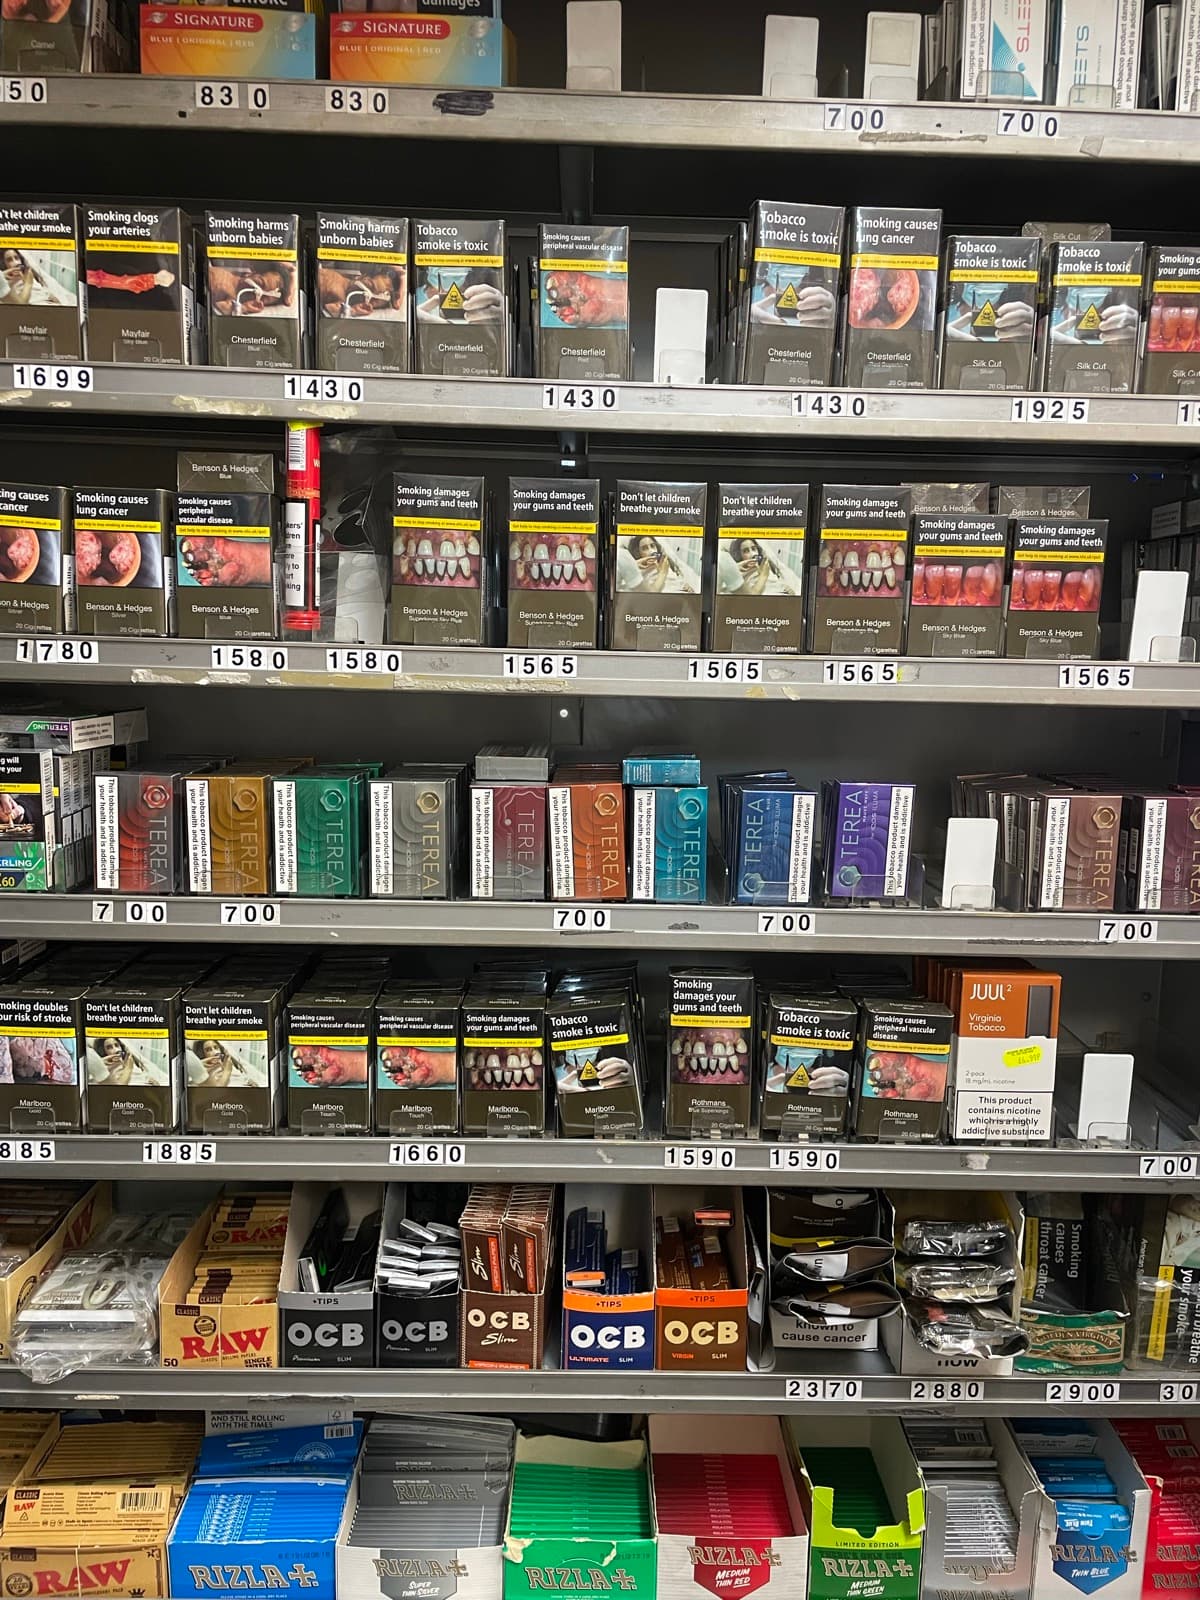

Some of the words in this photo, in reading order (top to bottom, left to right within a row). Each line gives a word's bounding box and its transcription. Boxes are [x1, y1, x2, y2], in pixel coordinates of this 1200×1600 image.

[175, 12, 255, 28] SIGNATURE
[363, 21, 441, 35] SIGNATURE
[30, 40, 55, 49] Camel
[1073, 26, 1089, 103] HEETS
[9, 81, 44, 102] 50
[331, 90, 386, 112] 830
[828, 108, 883, 130] 700
[1002, 113, 1058, 137] 700
[209, 217, 254, 231] Smoking
[256, 219, 289, 231] harms
[209, 232, 246, 243] unborn
[249, 233, 283, 245] babies
[543, 233, 569, 242] Smoking
[543, 242, 574, 250] peripheral
[122, 329, 150, 338] Mayfair
[231, 335, 277, 345] Chesterfield
[561, 347, 605, 356] Chesterfield
[987, 360, 1002, 368] Cut
[16, 367, 90, 388] 1699
[287, 377, 361, 400] 1430
[546, 388, 615, 408] 1430
[794, 395, 864, 416] 1430
[1014, 400, 1085, 420] 1925
[192, 464, 221, 472] Benson
[230, 464, 259, 473] Hedges
[621, 492, 644, 501] Don't
[645, 493, 656, 502] let
[658, 493, 690, 503] children
[620, 503, 652, 513] breathe
[654, 505, 672, 515] your
[674, 505, 700, 515] smoke
[920, 520, 956, 530] Smoking
[958, 521, 995, 531] damages
[919, 532, 938, 541] your
[940, 532, 962, 542] gums
[964, 531, 980, 541] and
[982, 531, 1003, 541] teeth
[1019, 628, 1046, 636] Benson
[1055, 629, 1083, 638] Hedges
[20, 641, 92, 661] 1780
[213, 647, 285, 669] 1580
[329, 650, 399, 671] 1580
[505, 656, 574, 674] 1565
[690, 661, 758, 679] 1565
[826, 663, 894, 682] 1565
[1062, 668, 1130, 686] 1565
[745, 798, 765, 866] TEREA
[841, 791, 862, 858] TEREA
[149, 816, 167, 885] TEREA
[240, 819, 259, 888] TEREA
[422, 821, 440, 890] TEREA
[683, 827, 700, 895] TEREA
[1093, 836, 1113, 903] TEREA
[225, 905, 275, 922] 700
[558, 910, 605, 927] 700
[762, 915, 810, 931] 700
[1104, 922, 1152, 939] 700
[970, 984, 1005, 1000] JUUL
[34, 1002, 68, 1011] doubles
[15, 1014, 31, 1022] risk
[32, 1014, 42, 1022] of
[44, 1015, 72, 1023] stroke
[778, 1011, 820, 1024] Tobacco
[969, 1013, 1001, 1023] Virginia
[777, 1026, 811, 1037] smoke
[814, 1028, 822, 1037] is
[825, 1028, 850, 1039] toxic
[968, 1023, 1005, 1032] Tobacco
[113, 1101, 144, 1109] Marlboro
[691, 1099, 726, 1107] Rothmans
[788, 1104, 822, 1113] Rothmans
[999, 1097, 1032, 1105] product
[144, 1143, 212, 1161] 1885
[393, 1145, 460, 1162] 1660
[667, 1148, 733, 1166] 1590
[772, 1150, 836, 1169] 1590
[1144, 1157, 1191, 1175] 700
[1039, 1222, 1052, 1265] throat
[1055, 1223, 1065, 1263] causes
[1067, 1224, 1082, 1278] Smoking
[1036, 1268, 1048, 1299] cancer
[176, 1308, 199, 1316] CLASSIC
[468, 1309, 530, 1329] OCB
[288, 1322, 364, 1347] OCB
[481, 1333, 518, 1346] Slim
[571, 1324, 645, 1349] OCB
[665, 1320, 739, 1345] OCB
[782, 1332, 820, 1342] cause
[824, 1333, 867, 1342] cancer
[180, 1327, 270, 1359] RAW
[164, 1358, 178, 1367] 50
[789, 1381, 856, 1398] 2370
[914, 1382, 979, 1399] 2880
[1051, 1384, 1114, 1400] 2900
[1163, 1385, 1193, 1399] 30
[14, 1502, 35, 1512] RAW
[33, 1559, 131, 1595] RAW
[716, 1578, 731, 1587] THIN
[734, 1577, 750, 1585] RED
